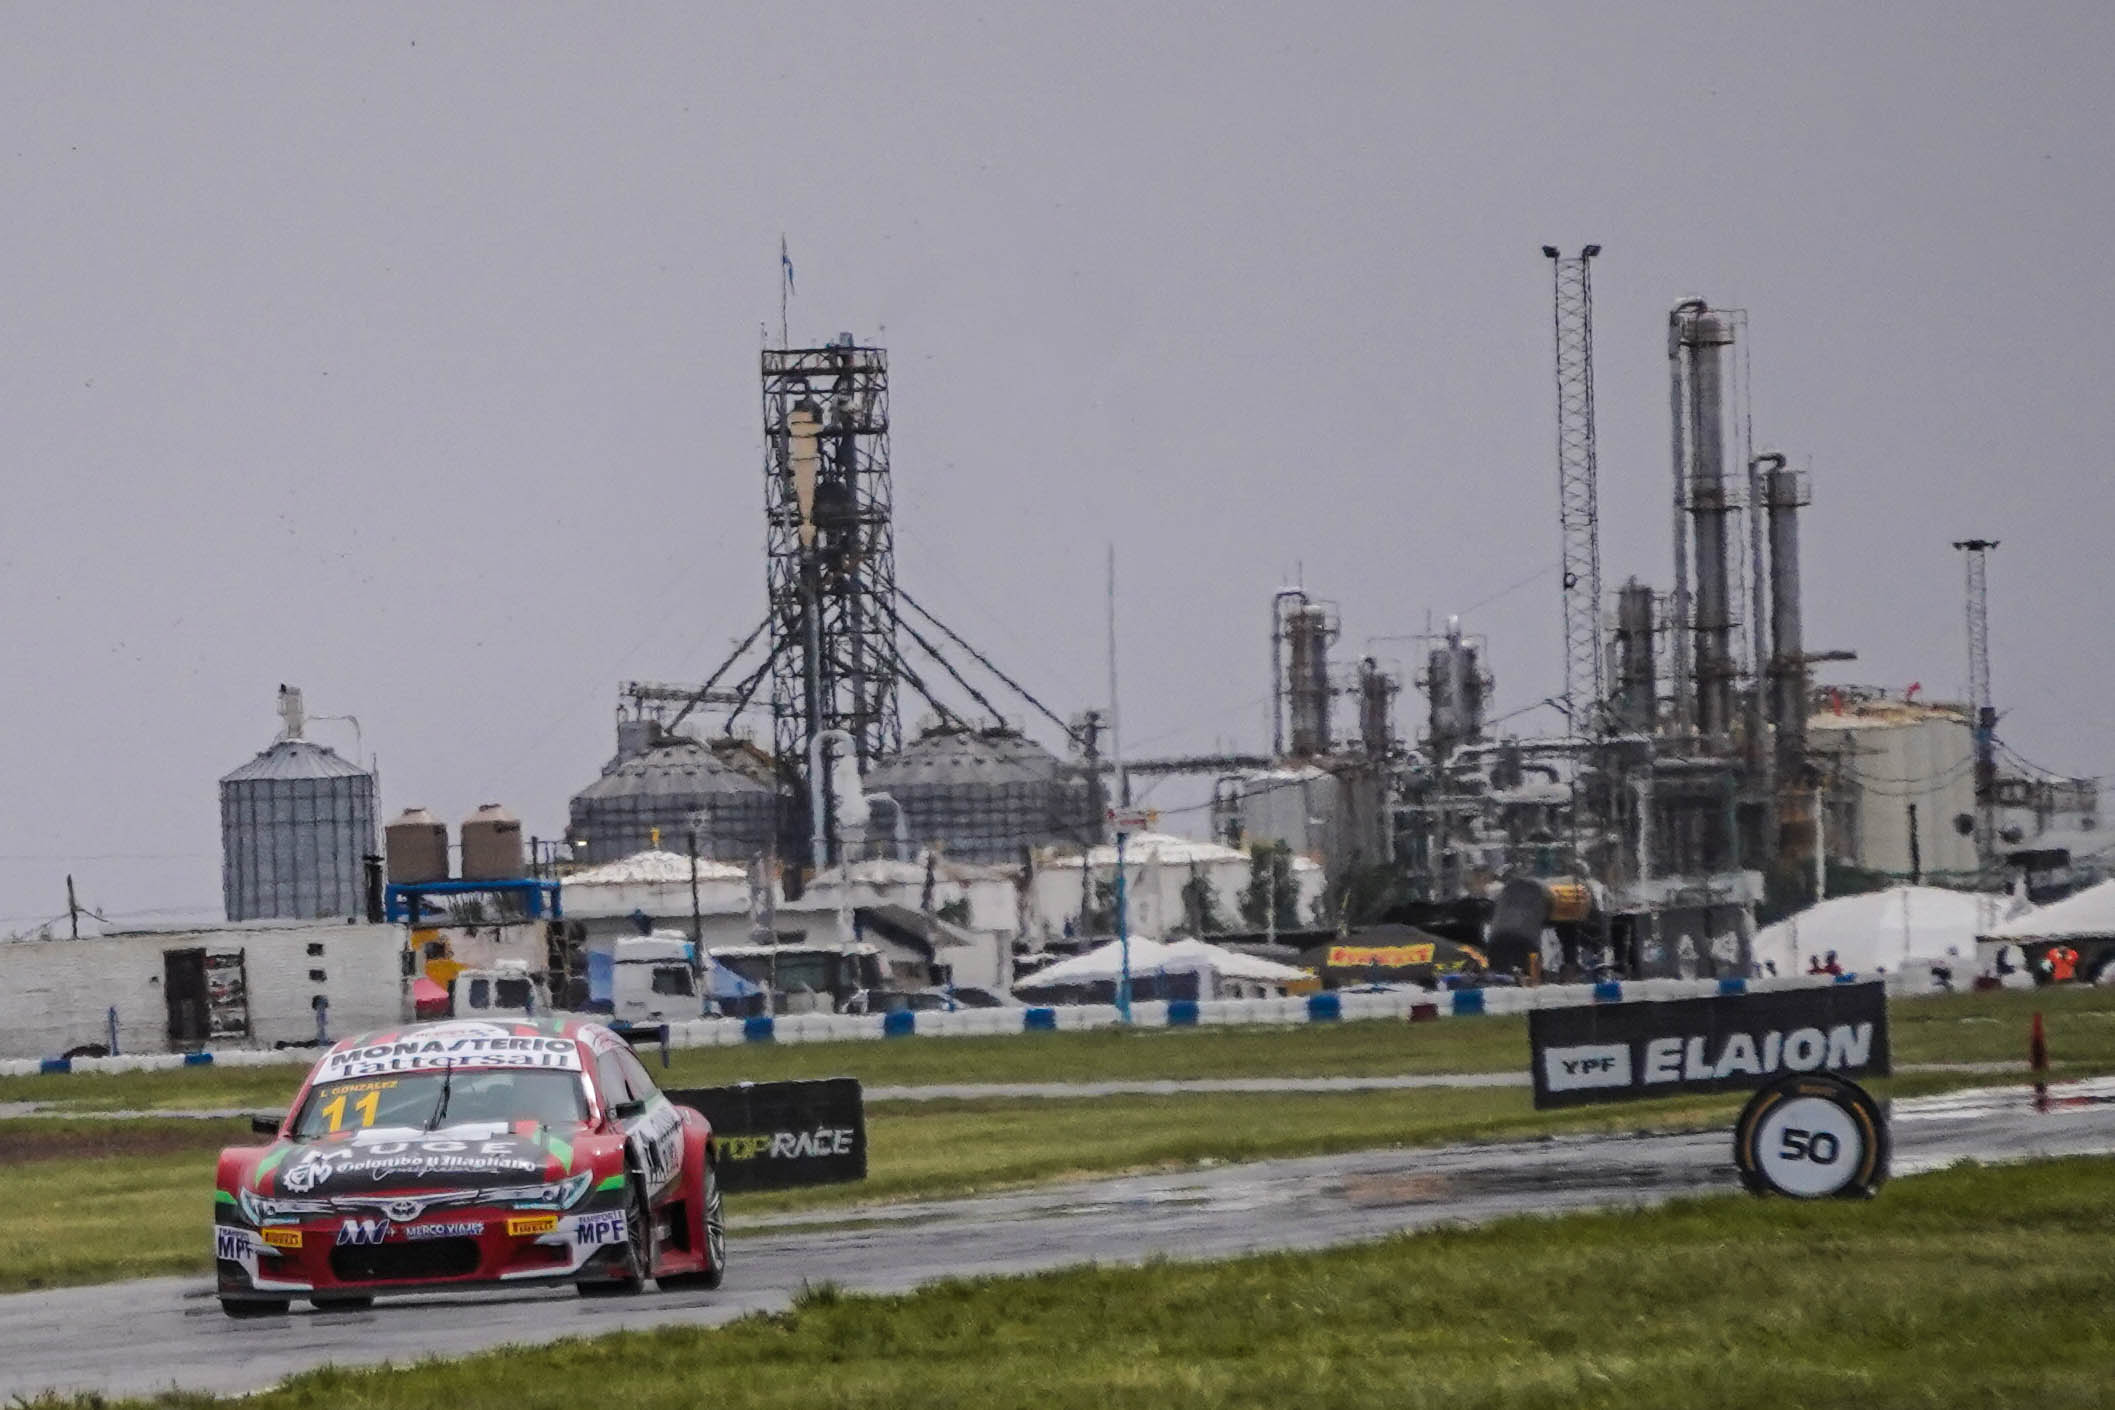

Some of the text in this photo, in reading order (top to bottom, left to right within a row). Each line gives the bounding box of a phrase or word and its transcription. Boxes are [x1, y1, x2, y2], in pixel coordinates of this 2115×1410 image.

[331, 1038, 576, 1067] MONASTERIO
[342, 1052, 569, 1077] Tattersall
[1561, 1022, 1873, 1085] YPF ELAION
[321, 1090, 380, 1133] 11
[1779, 1127, 1840, 1165] 50
[406, 1225, 445, 1236] MERCO
[578, 1220, 625, 1245] MPF
[218, 1236, 254, 1260] MPF
